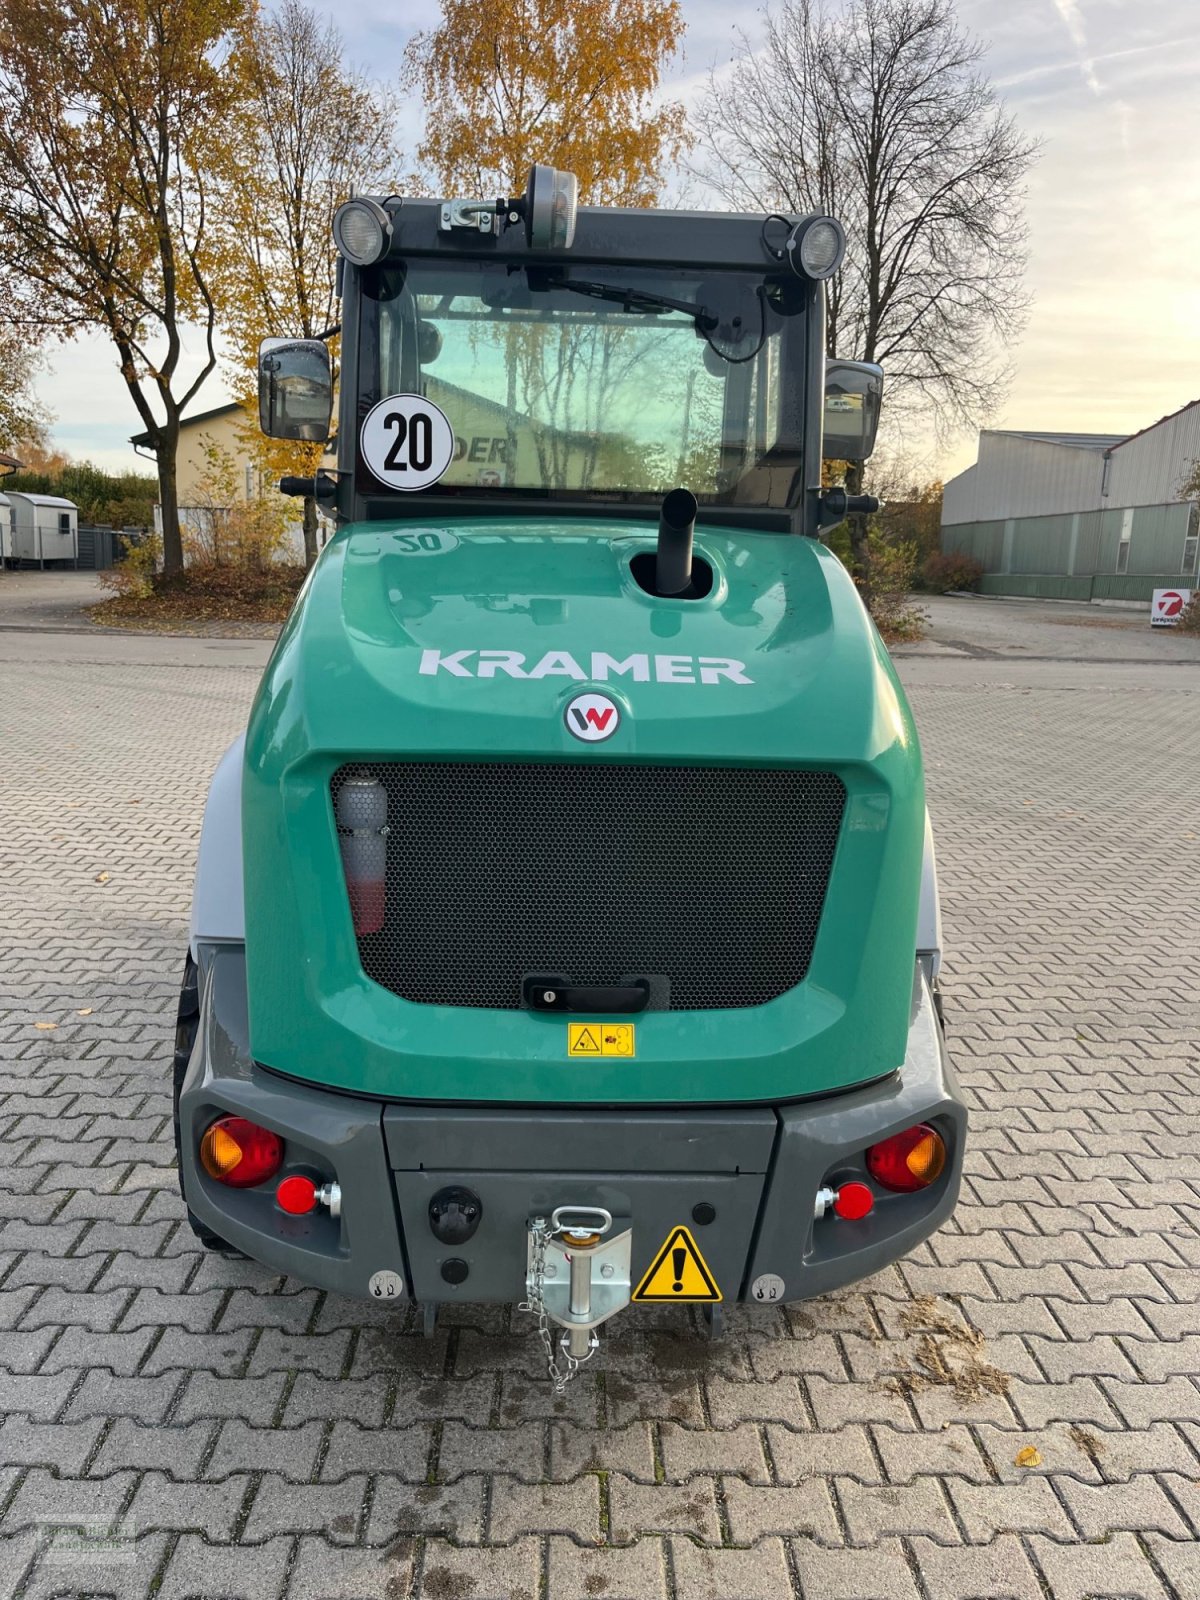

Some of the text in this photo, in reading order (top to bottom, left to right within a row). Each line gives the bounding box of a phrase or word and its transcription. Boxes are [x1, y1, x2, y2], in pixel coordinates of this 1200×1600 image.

[384, 412, 433, 472] 20
[418, 649, 756, 685] KRAMER
[570, 707, 615, 731] W
